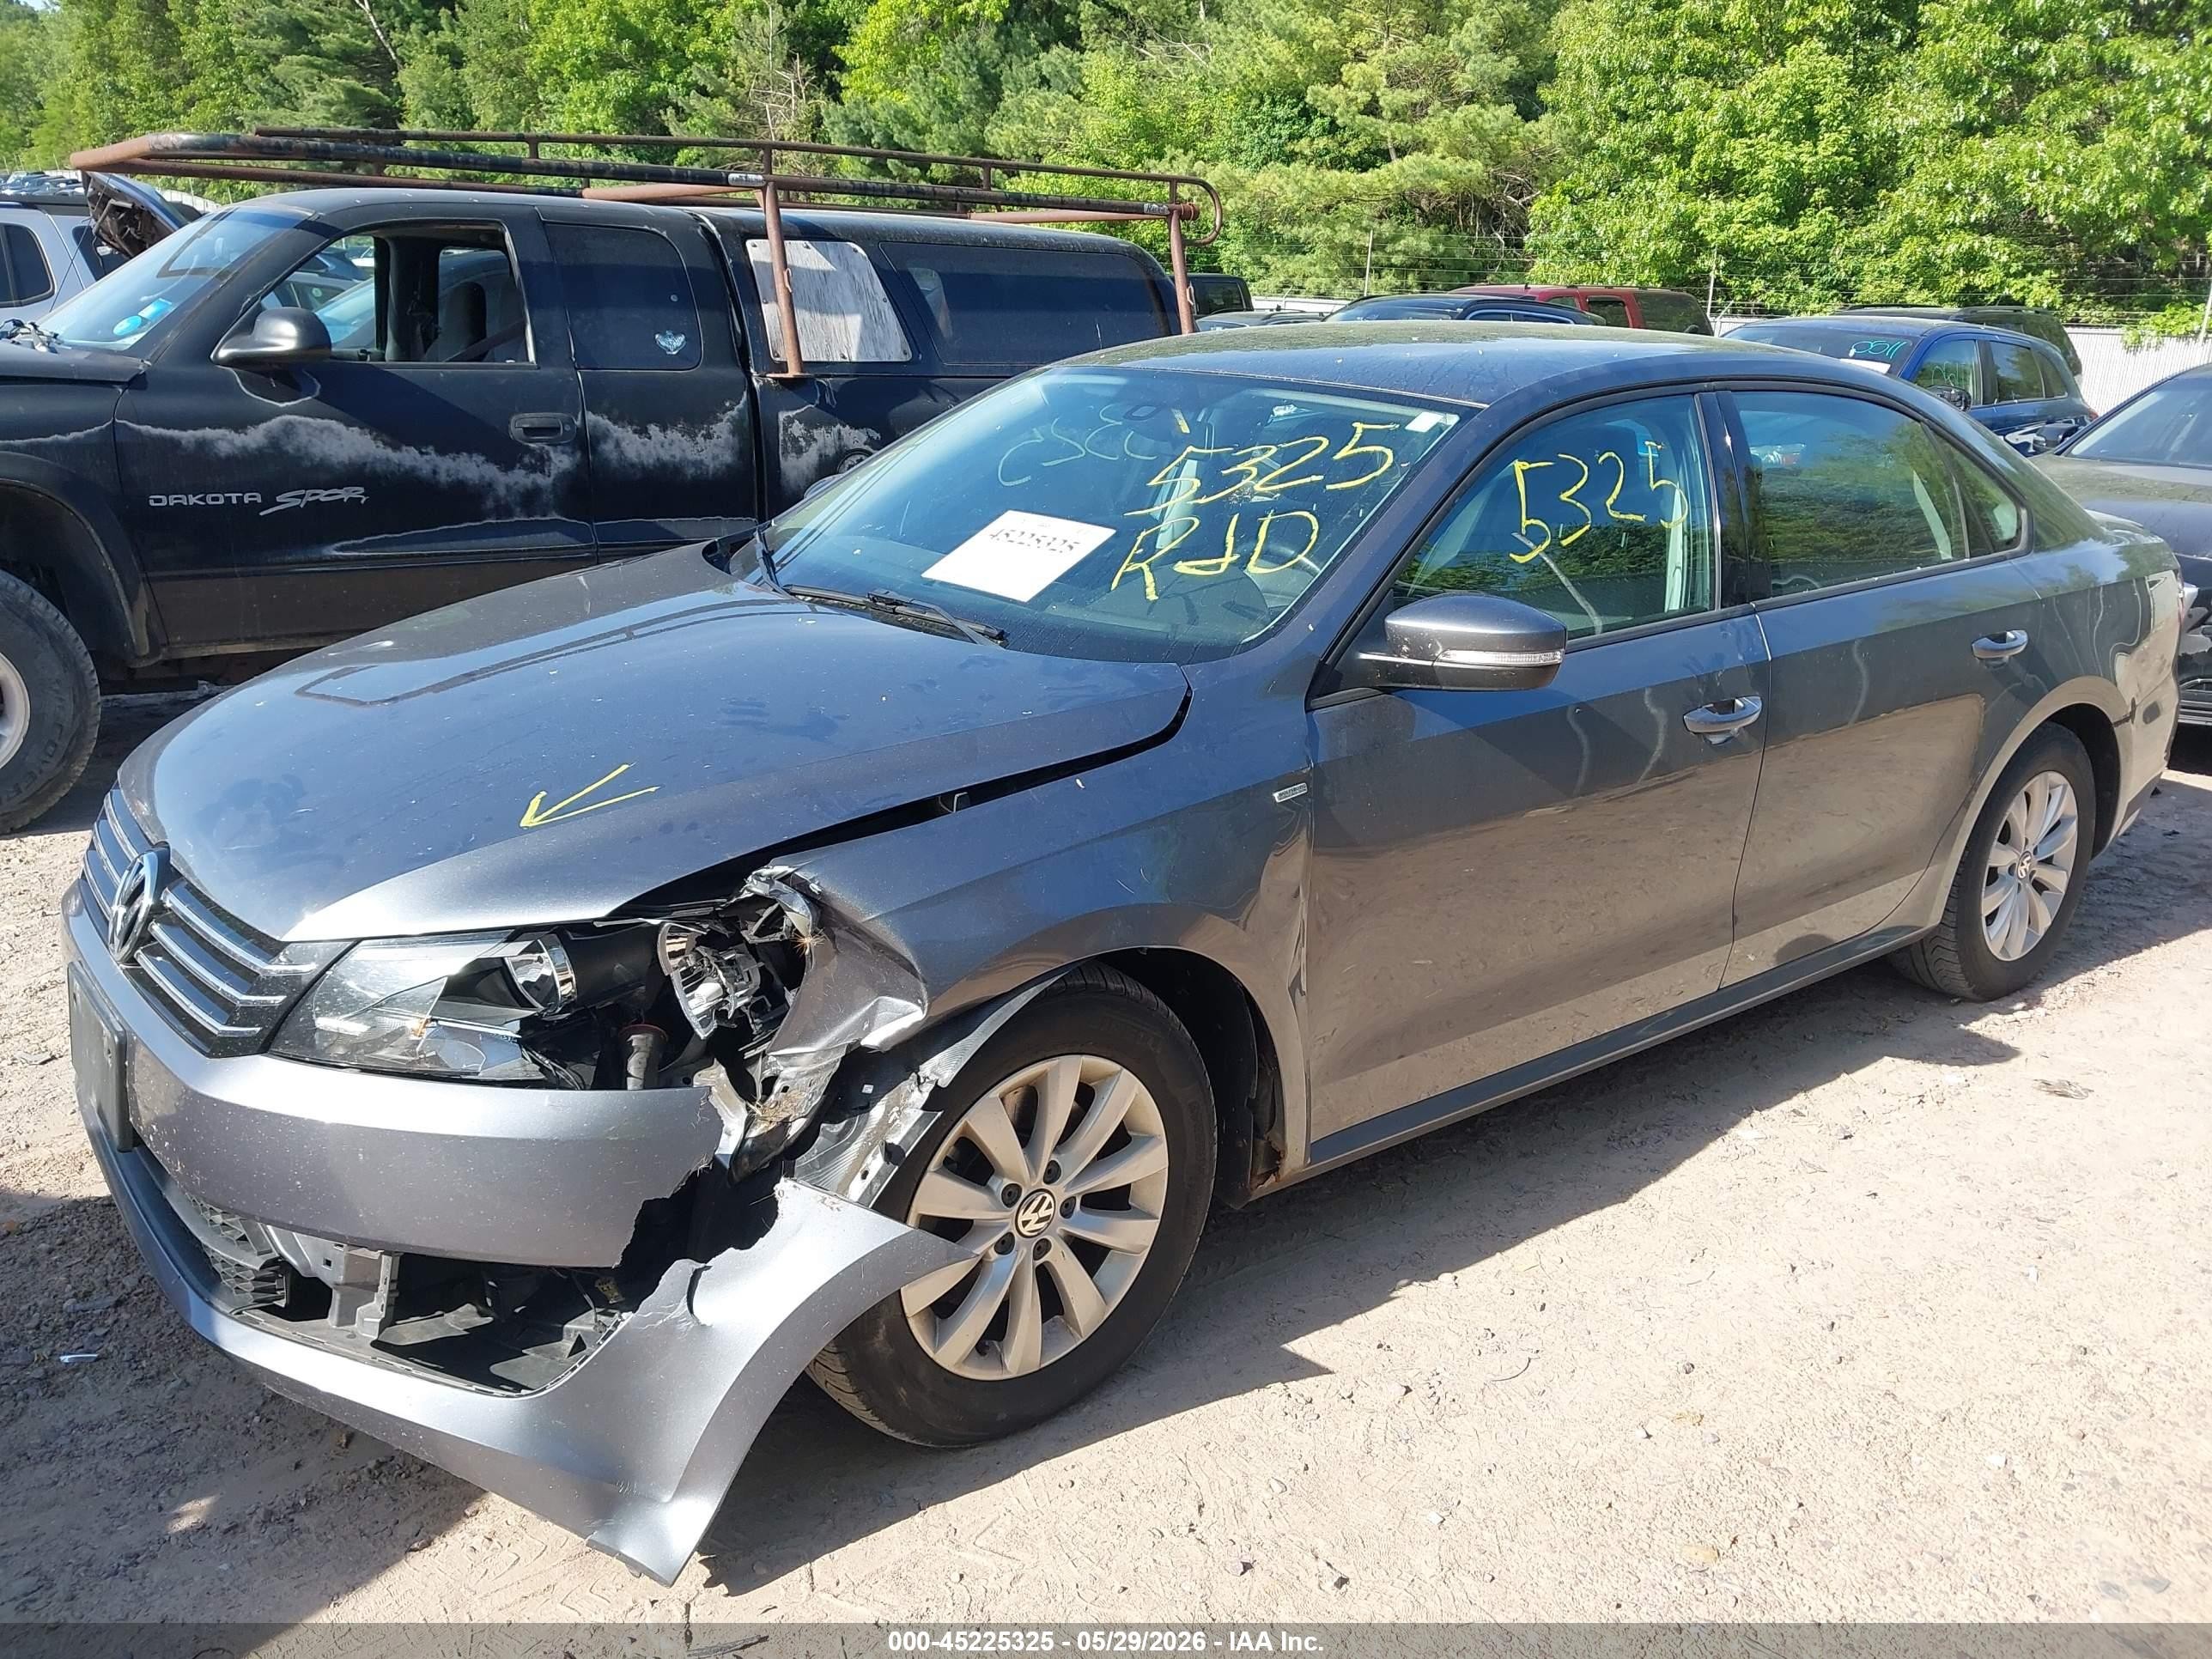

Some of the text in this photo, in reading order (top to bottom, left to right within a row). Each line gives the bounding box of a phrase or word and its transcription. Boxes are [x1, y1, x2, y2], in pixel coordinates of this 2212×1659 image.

[149, 486, 369, 516] DAKOTA SPOR
[1123, 422, 1400, 516] 5325
[1509, 441, 1689, 563] 5325
